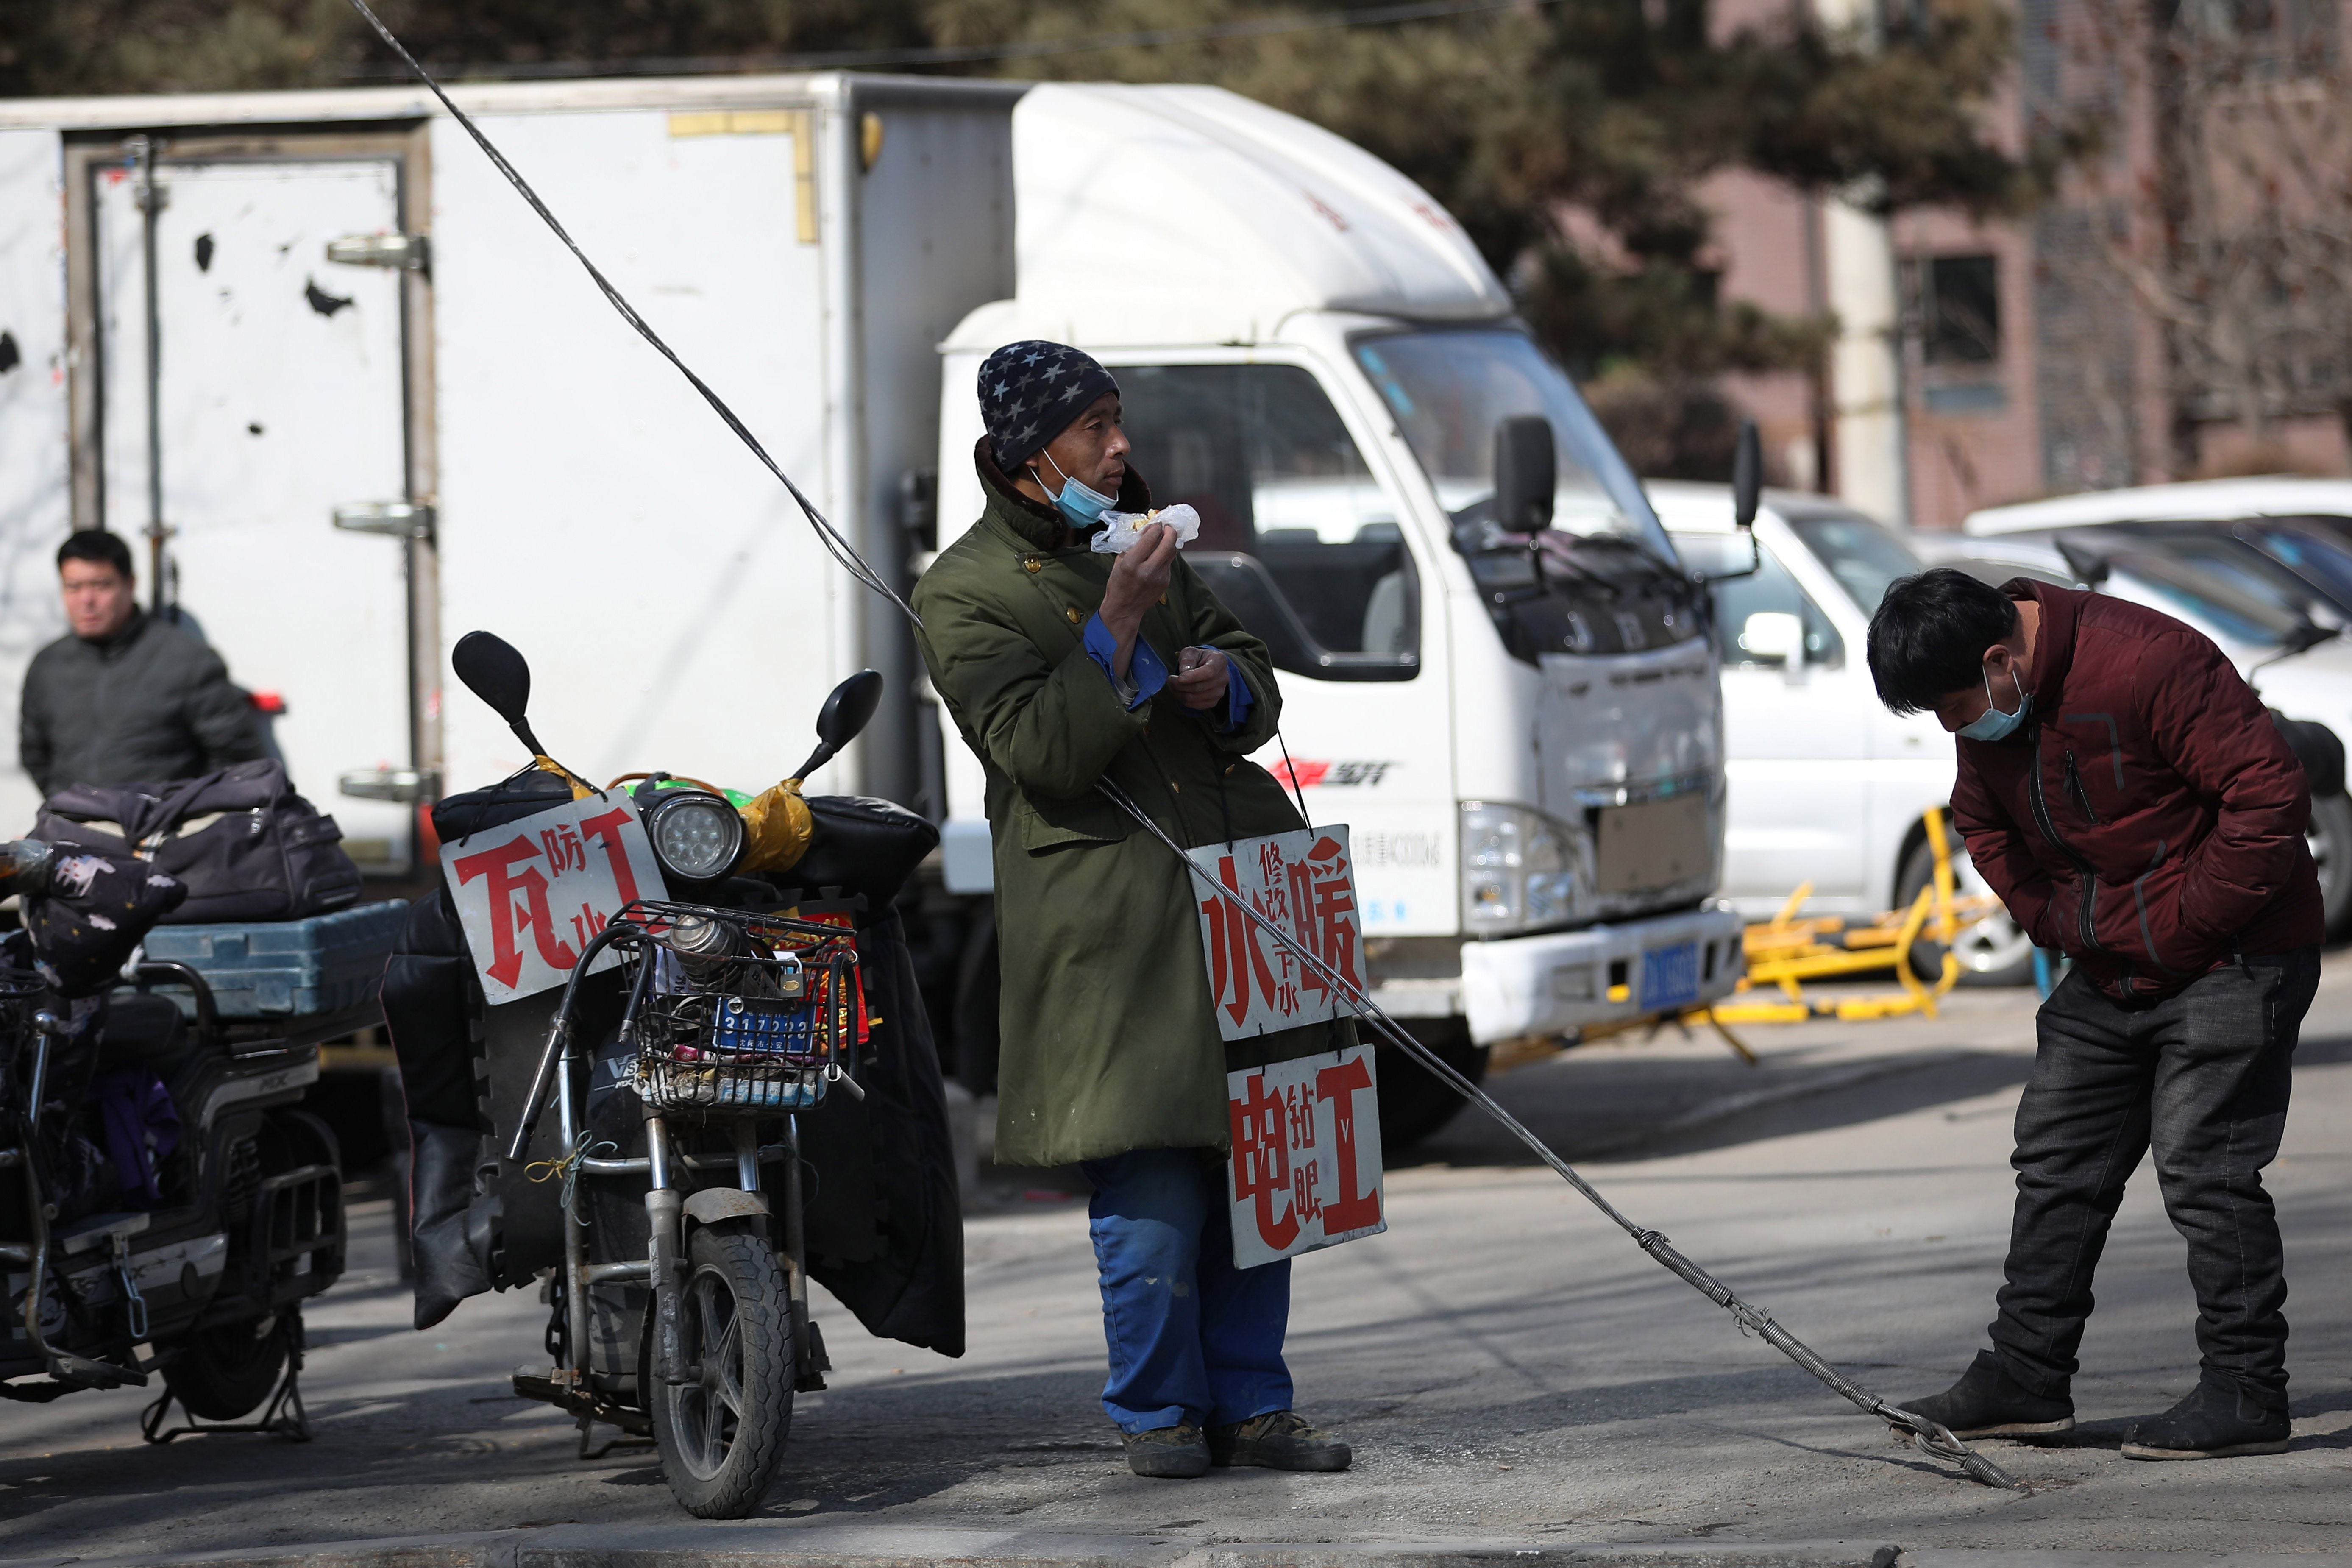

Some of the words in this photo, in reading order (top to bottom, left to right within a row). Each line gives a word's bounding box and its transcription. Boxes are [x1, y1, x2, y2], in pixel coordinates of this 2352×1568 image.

[1201, 836, 1363, 1028] 水暖
[1230, 1054, 1381, 1251] 电工
[1286, 1082, 1322, 1224] 钻眼
